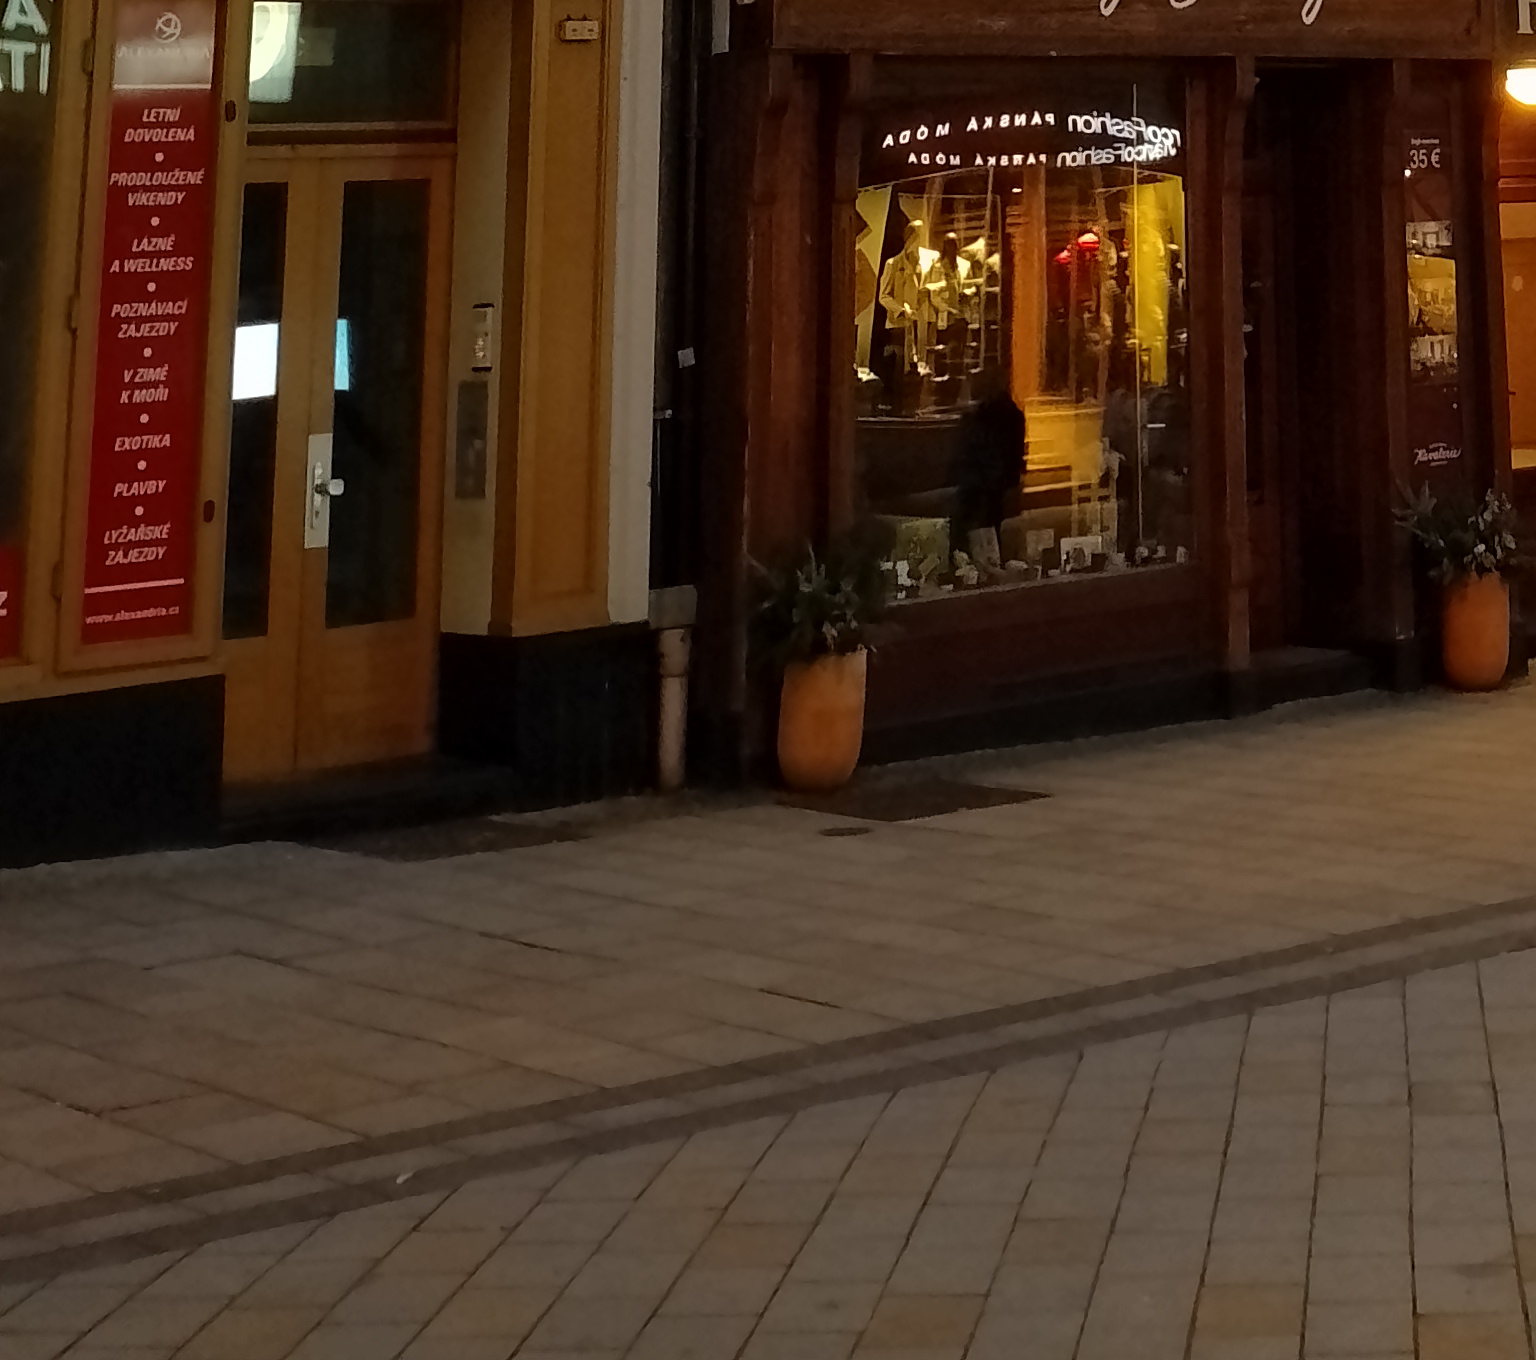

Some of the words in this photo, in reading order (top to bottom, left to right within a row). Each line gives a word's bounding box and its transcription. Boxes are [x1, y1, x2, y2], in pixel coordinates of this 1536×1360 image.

[0, 39, 51, 96] TI
[142, 106, 182, 122] LETNÍ
[124, 125, 195, 142] DOVOLENÁ
[1410, 149, 1428, 169] 35
[1431, 148, 1441, 168] €
[109, 168, 205, 186] PRODLOUŽENÉ
[128, 189, 186, 206] VÍKENDY
[132, 234, 176, 252] LÁZNĚ
[109, 259, 120, 273] A
[124, 257, 194, 272] WELLNESS
[111, 298, 188, 318] POZNÁVACÍ
[118, 321, 179, 338] ZÁJEZDY
[123, 369, 133, 383] V
[134, 364, 169, 382] ZIMĚ
[120, 390, 131, 404] K
[115, 434, 171, 451] EXOTIKA
[113, 480, 167, 497] PLAVBY
[104, 521, 171, 544] LYŽAŘSKÉ
[105, 546, 168, 566] ZÁJEZDY
